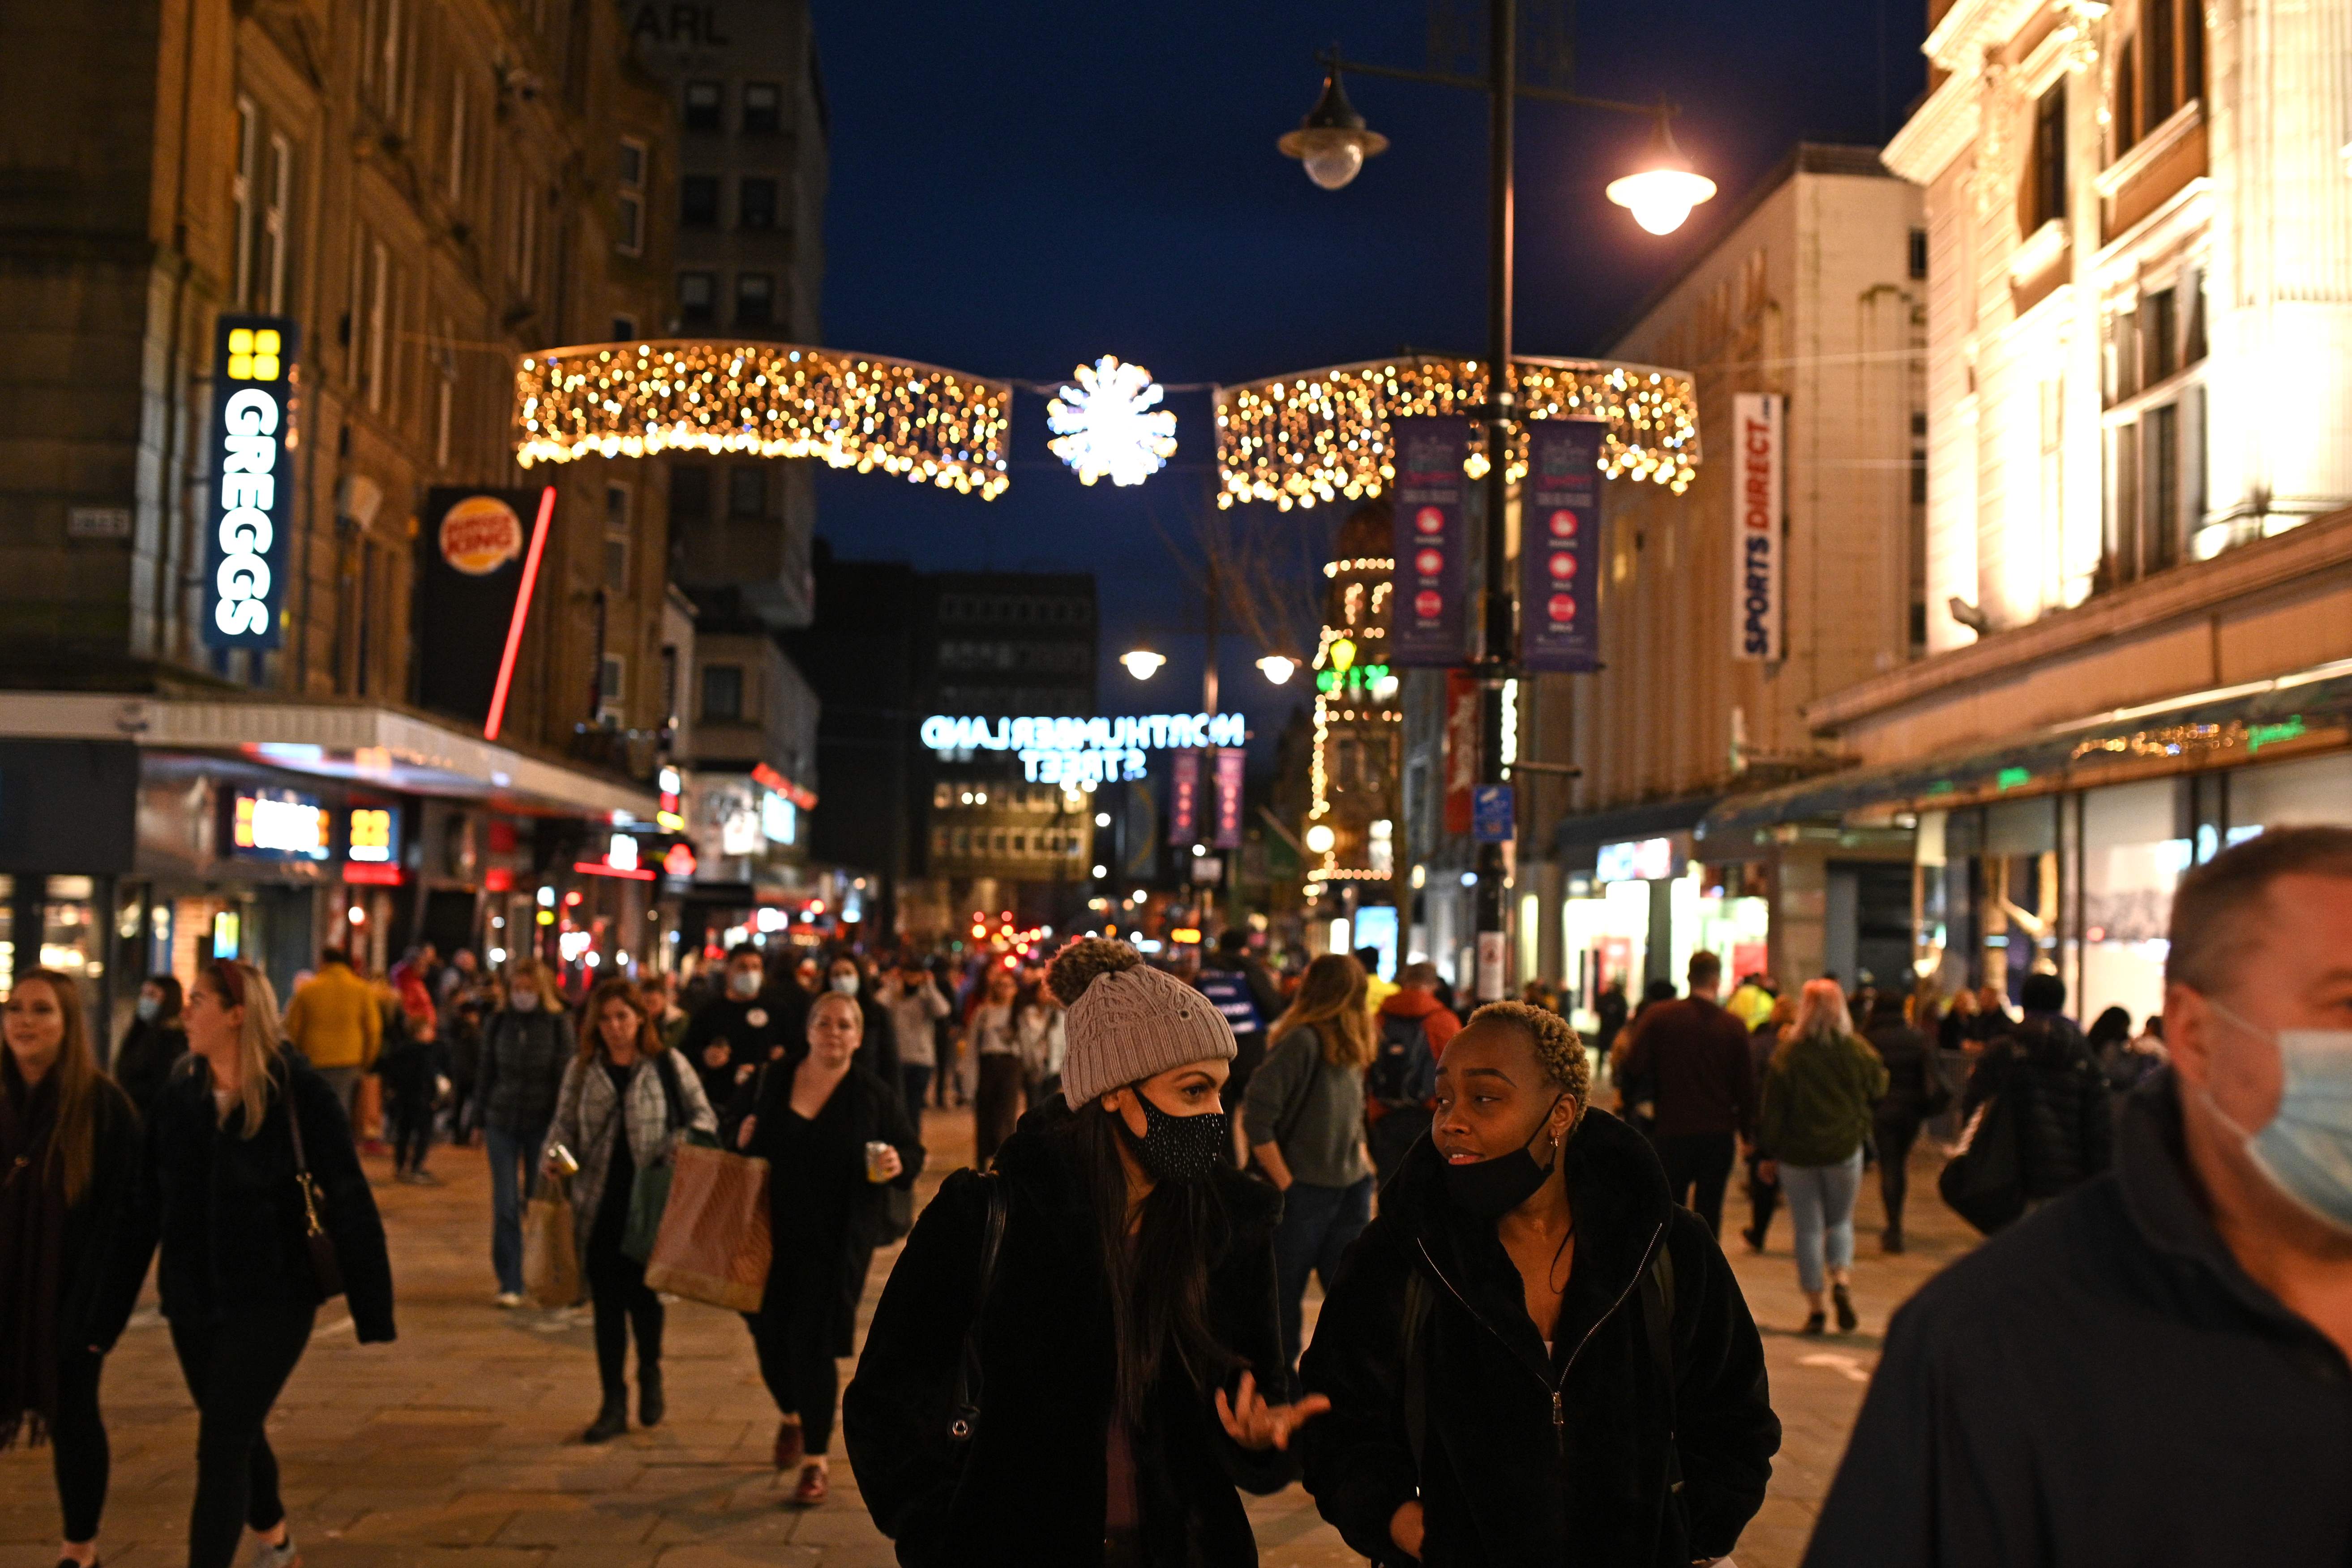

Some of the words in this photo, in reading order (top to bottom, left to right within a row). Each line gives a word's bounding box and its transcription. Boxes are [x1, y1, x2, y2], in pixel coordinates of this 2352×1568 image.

[215, 388, 279, 635] GREGGS
[1745, 416, 1771, 530] DIRECT
[1744, 534, 1770, 654] SPORTS
